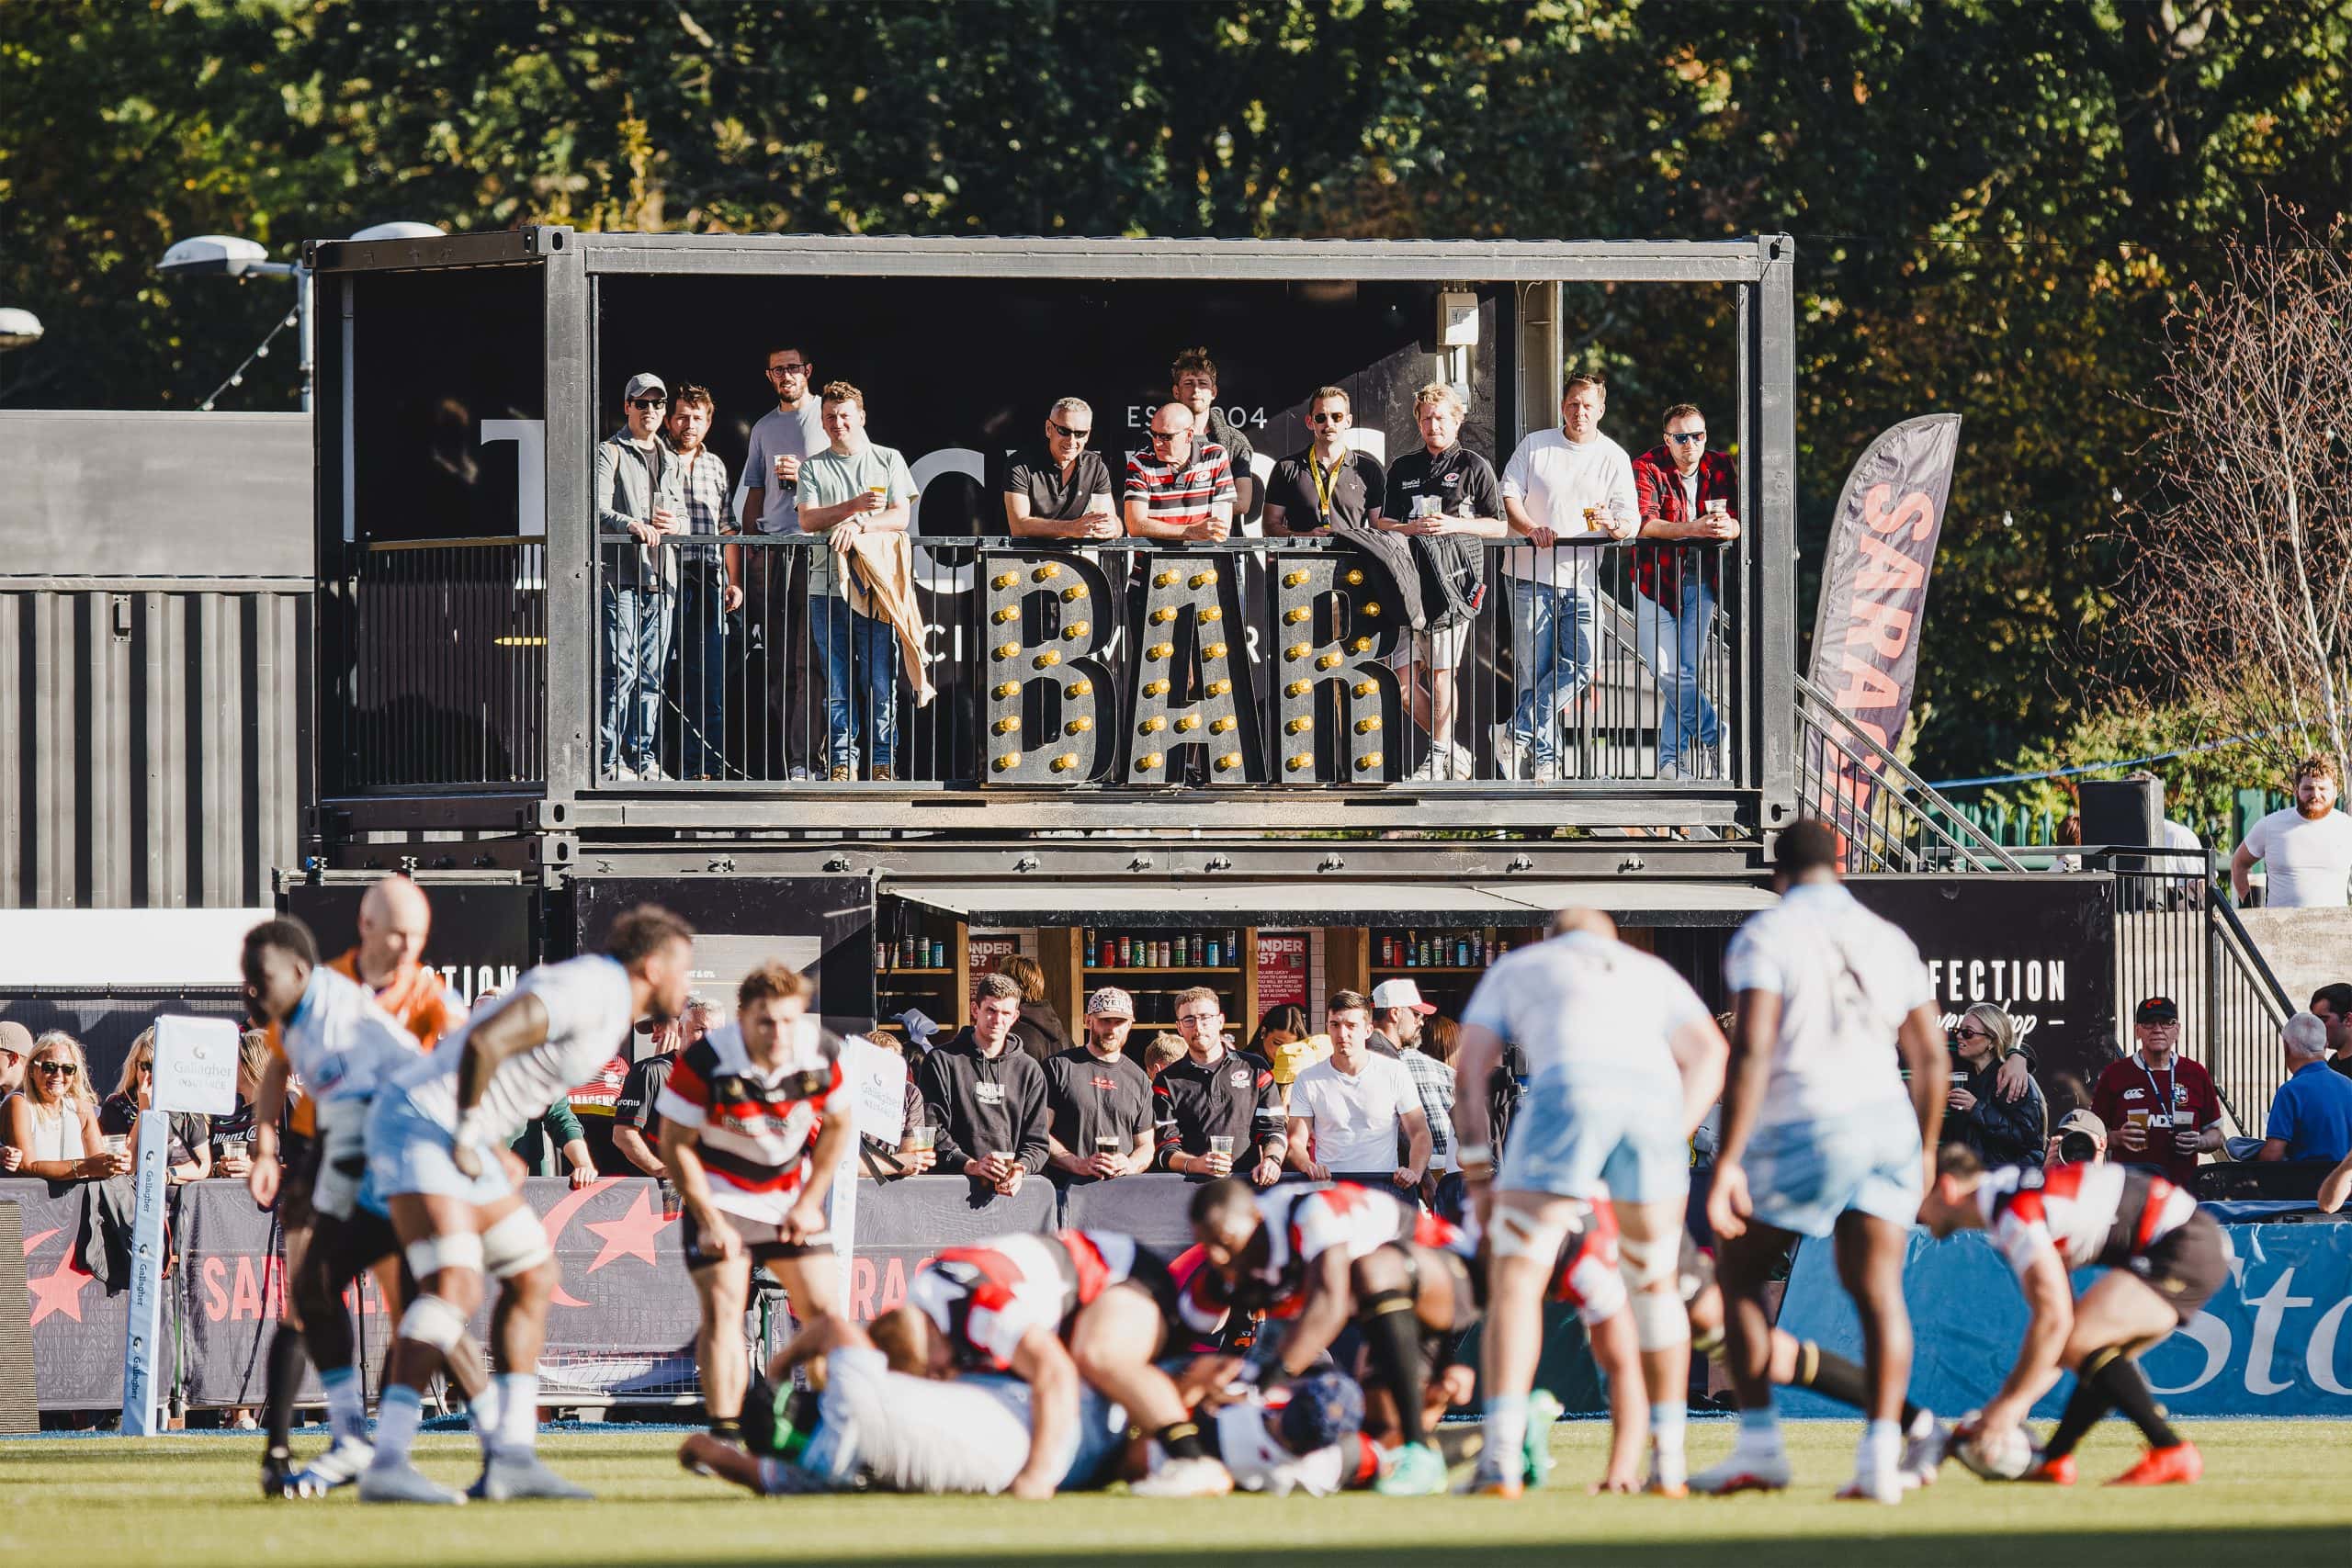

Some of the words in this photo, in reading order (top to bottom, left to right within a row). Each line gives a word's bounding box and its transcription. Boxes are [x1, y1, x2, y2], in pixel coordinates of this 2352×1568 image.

[986, 551, 1404, 784] BAR
[970, 955, 988, 967] 5?
[1259, 953, 1277, 964] 5?
[1928, 960, 2065, 1002] FECTION
[567, 1095, 616, 1107] ARACENS
[213, 1131, 245, 1145] llianz
